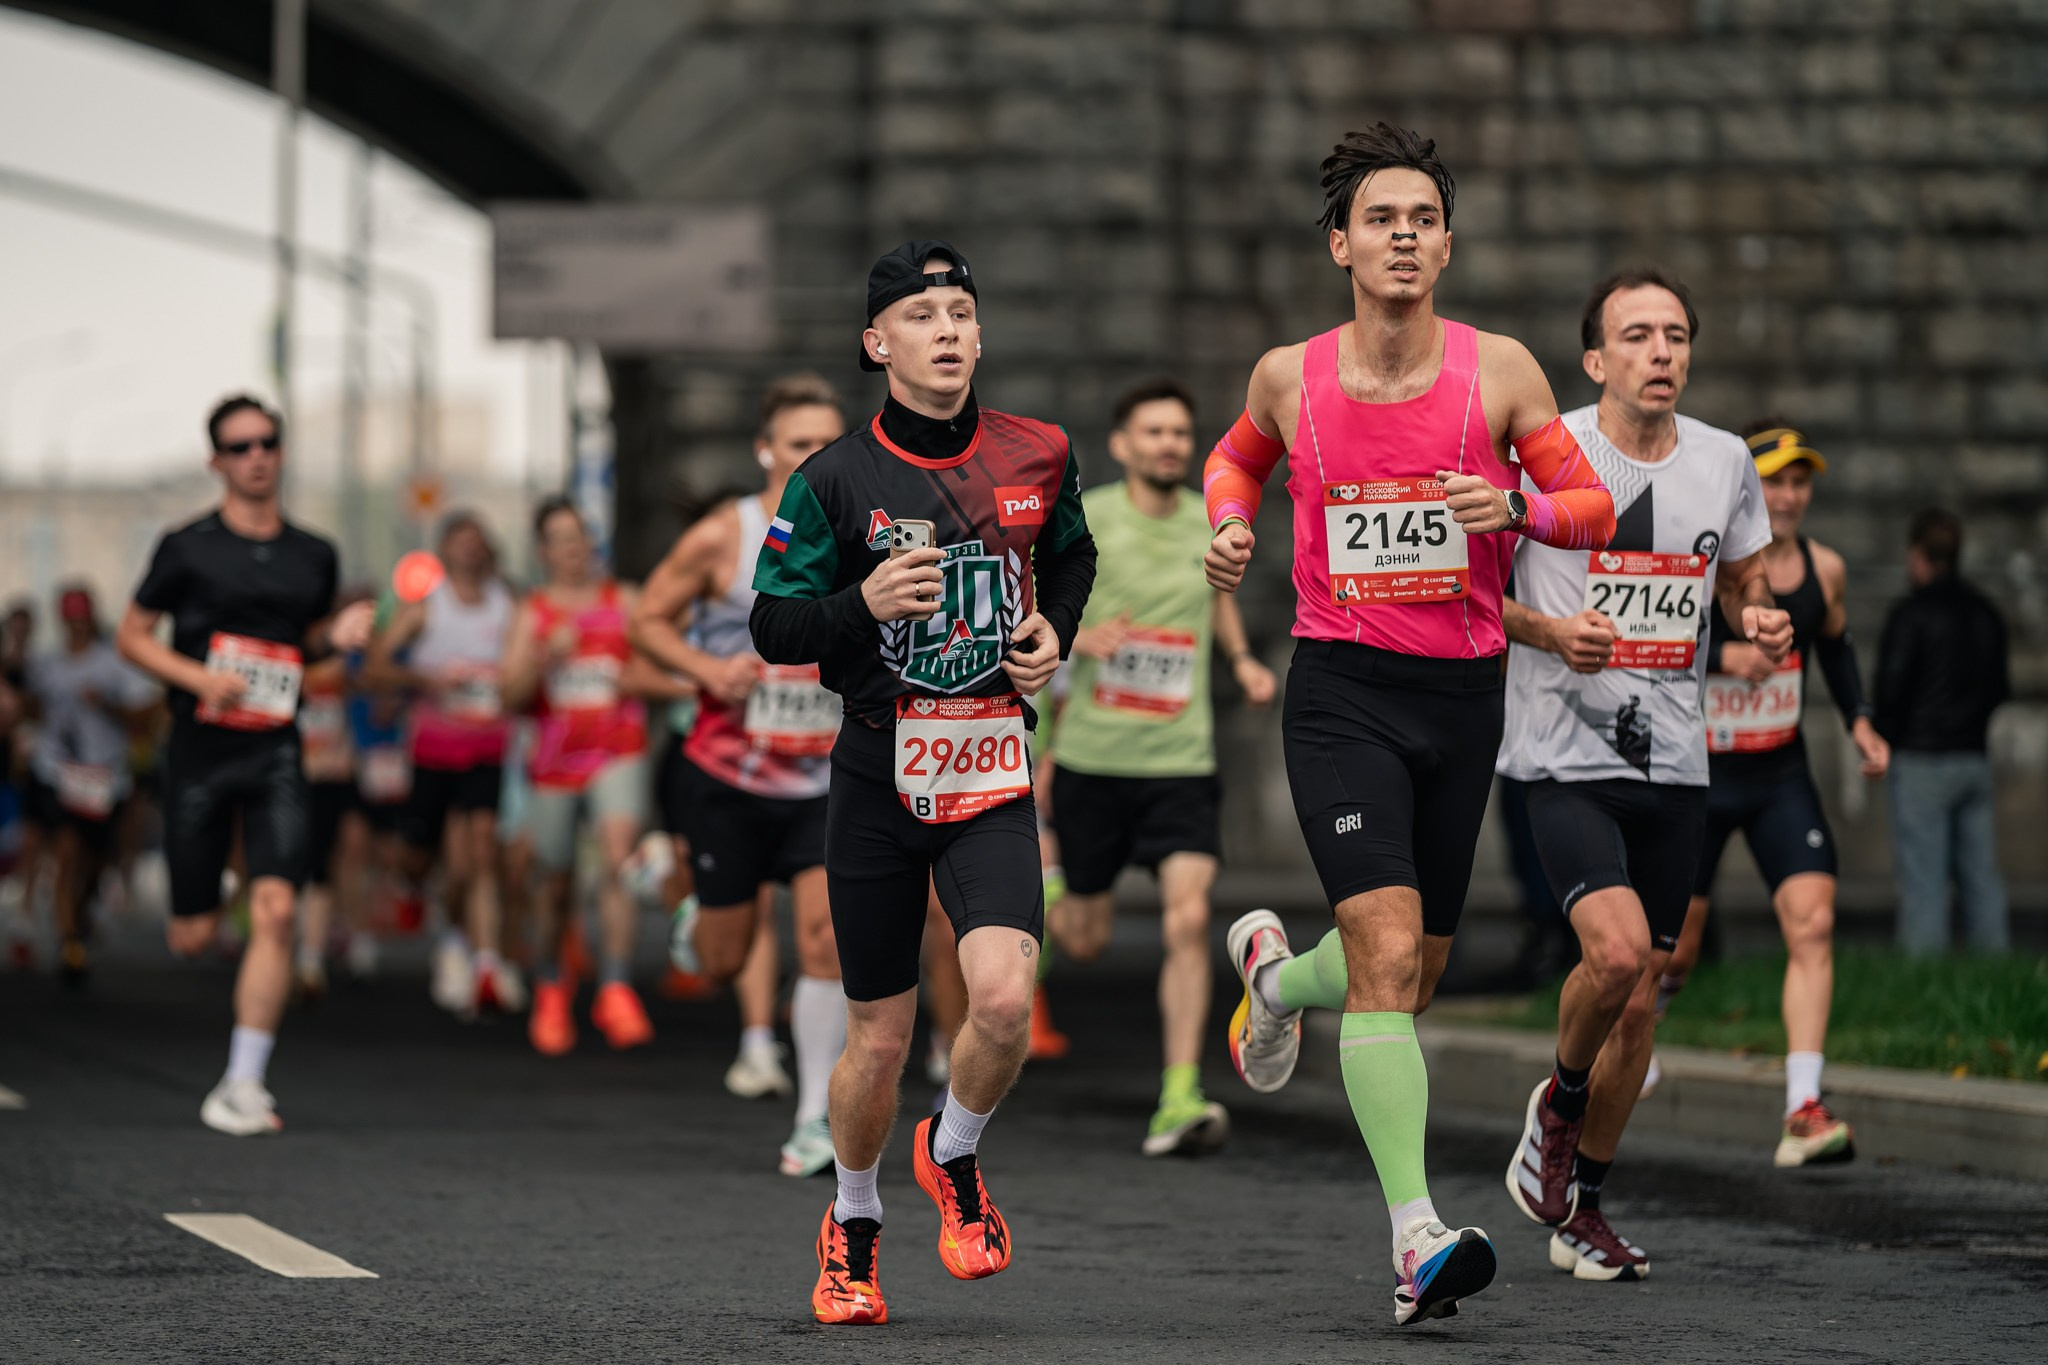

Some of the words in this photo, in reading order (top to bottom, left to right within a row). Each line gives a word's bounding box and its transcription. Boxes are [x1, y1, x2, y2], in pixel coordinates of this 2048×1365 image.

[1363, 486, 1411, 494] МОСКОВСКИЙ
[1345, 509, 1447, 550] 2145
[1375, 553, 1420, 567] ДЭННИ
[1592, 581, 1696, 618] 27146
[1630, 623, 1656, 634] ИЛЬЯ
[939, 702, 985, 710] МОСКОВСКИЙ
[903, 735, 1021, 776] 29680
[1335, 812, 1362, 835] GRi
